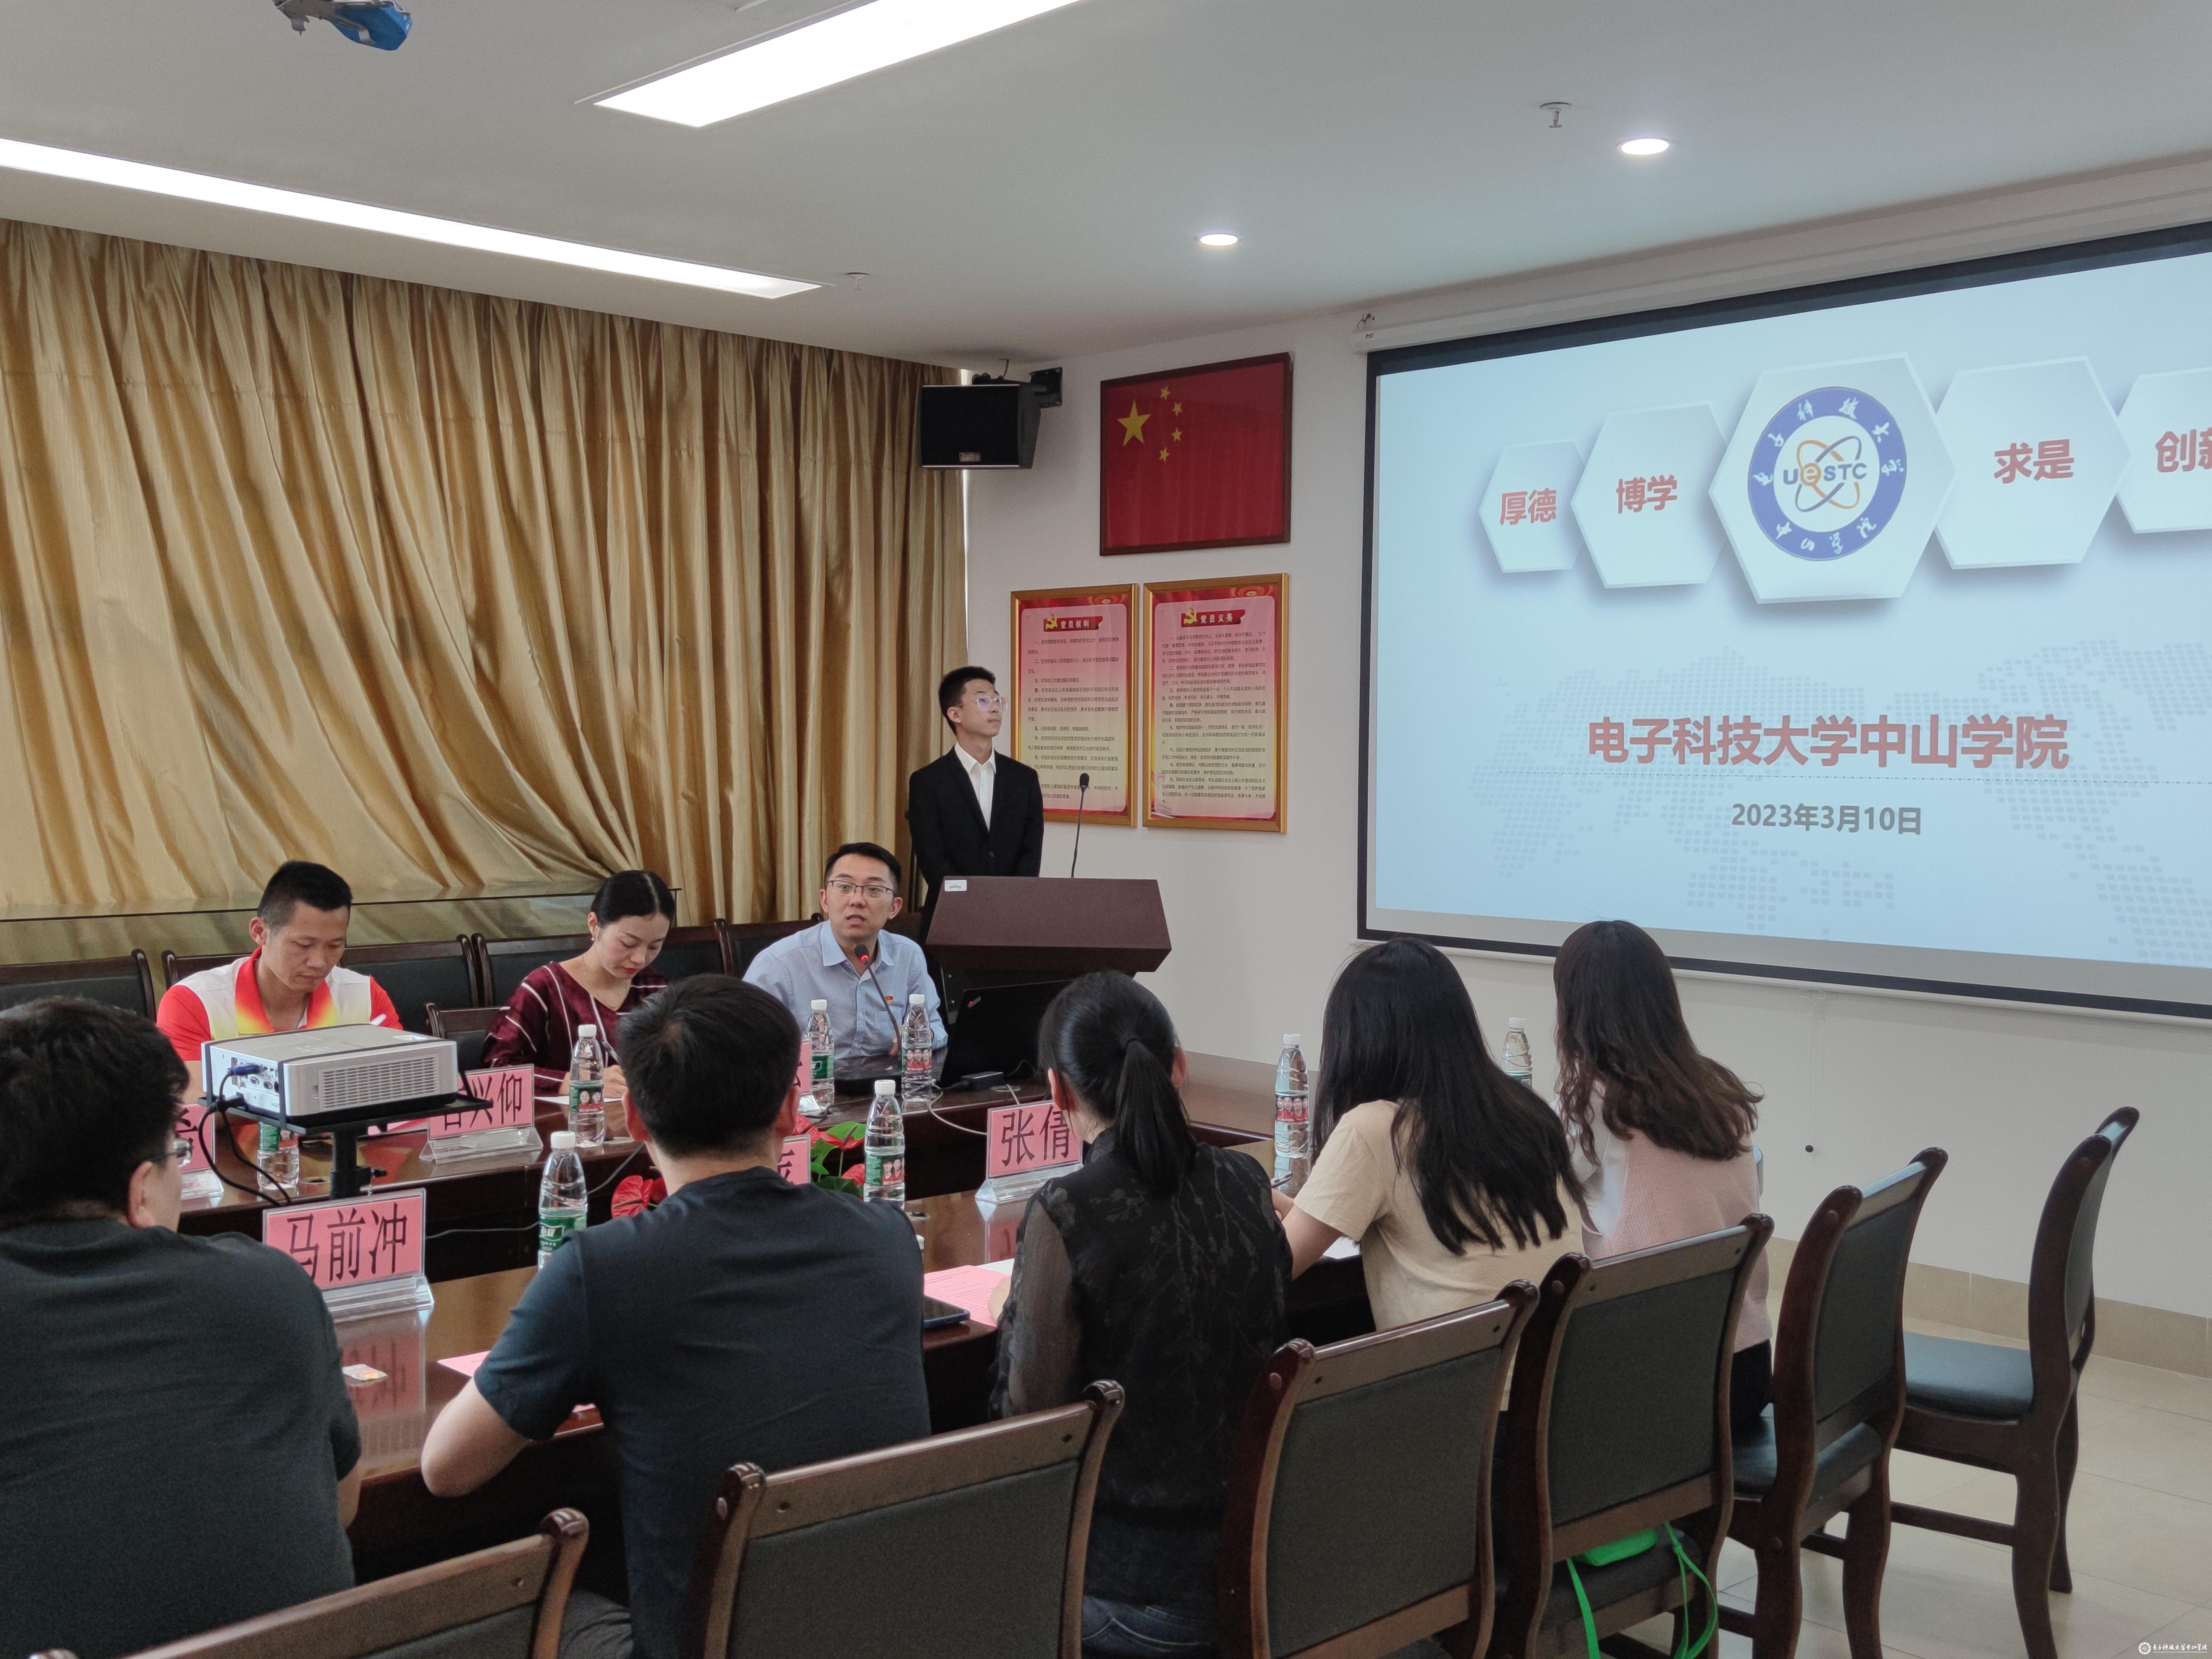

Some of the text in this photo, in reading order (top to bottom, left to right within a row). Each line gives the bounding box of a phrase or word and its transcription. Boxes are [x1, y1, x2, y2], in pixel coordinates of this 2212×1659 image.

[1994, 439, 2074, 484] 求是
[1499, 488, 1557, 526] 厚德
[1616, 474, 1678, 514] 博学
[1061, 619, 1090, 629] 党员权利
[1200, 613, 1233, 624] 党员义务
[1588, 713, 2070, 769] 电子科技大学中山学院
[1732, 803, 1922, 835] 2023年3月10日
[1001, 1104, 1070, 1167] 张倩
[286, 1202, 407, 1283] 马前冲
